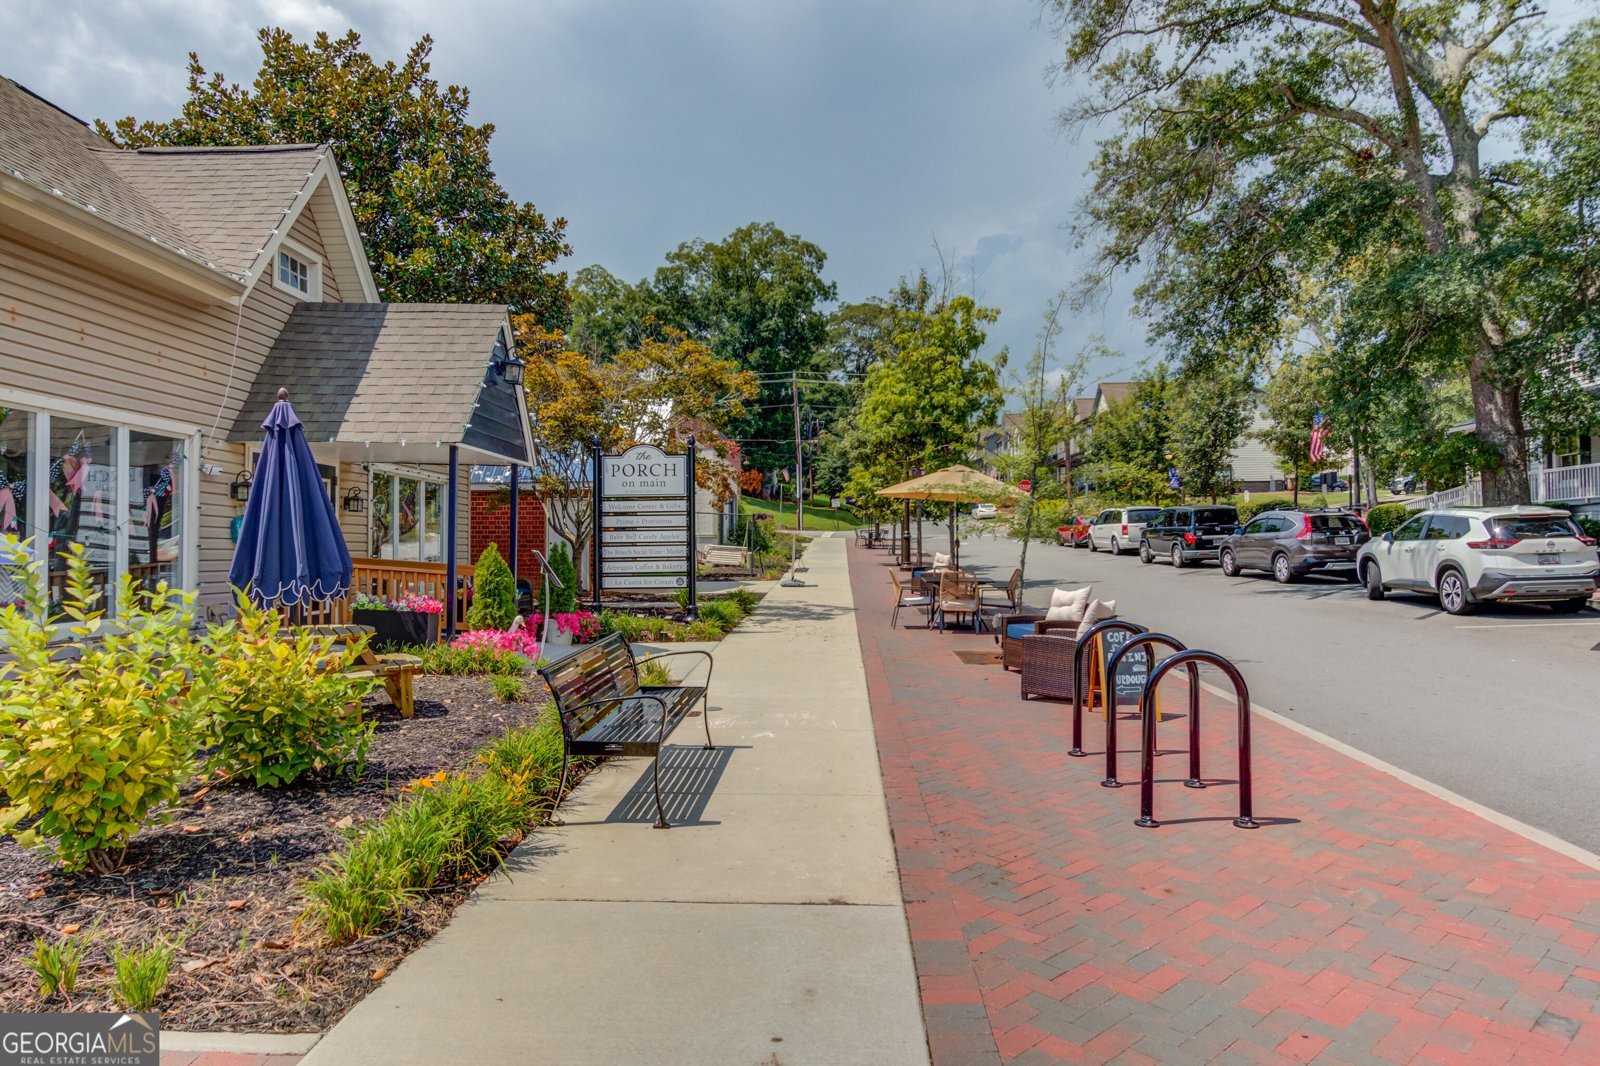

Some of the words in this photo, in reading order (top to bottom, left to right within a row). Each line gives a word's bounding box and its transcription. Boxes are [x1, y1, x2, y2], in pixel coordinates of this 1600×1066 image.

[635, 451, 652, 460] the
[611, 464, 677, 477] PORCH
[640, 479, 666, 488] main
